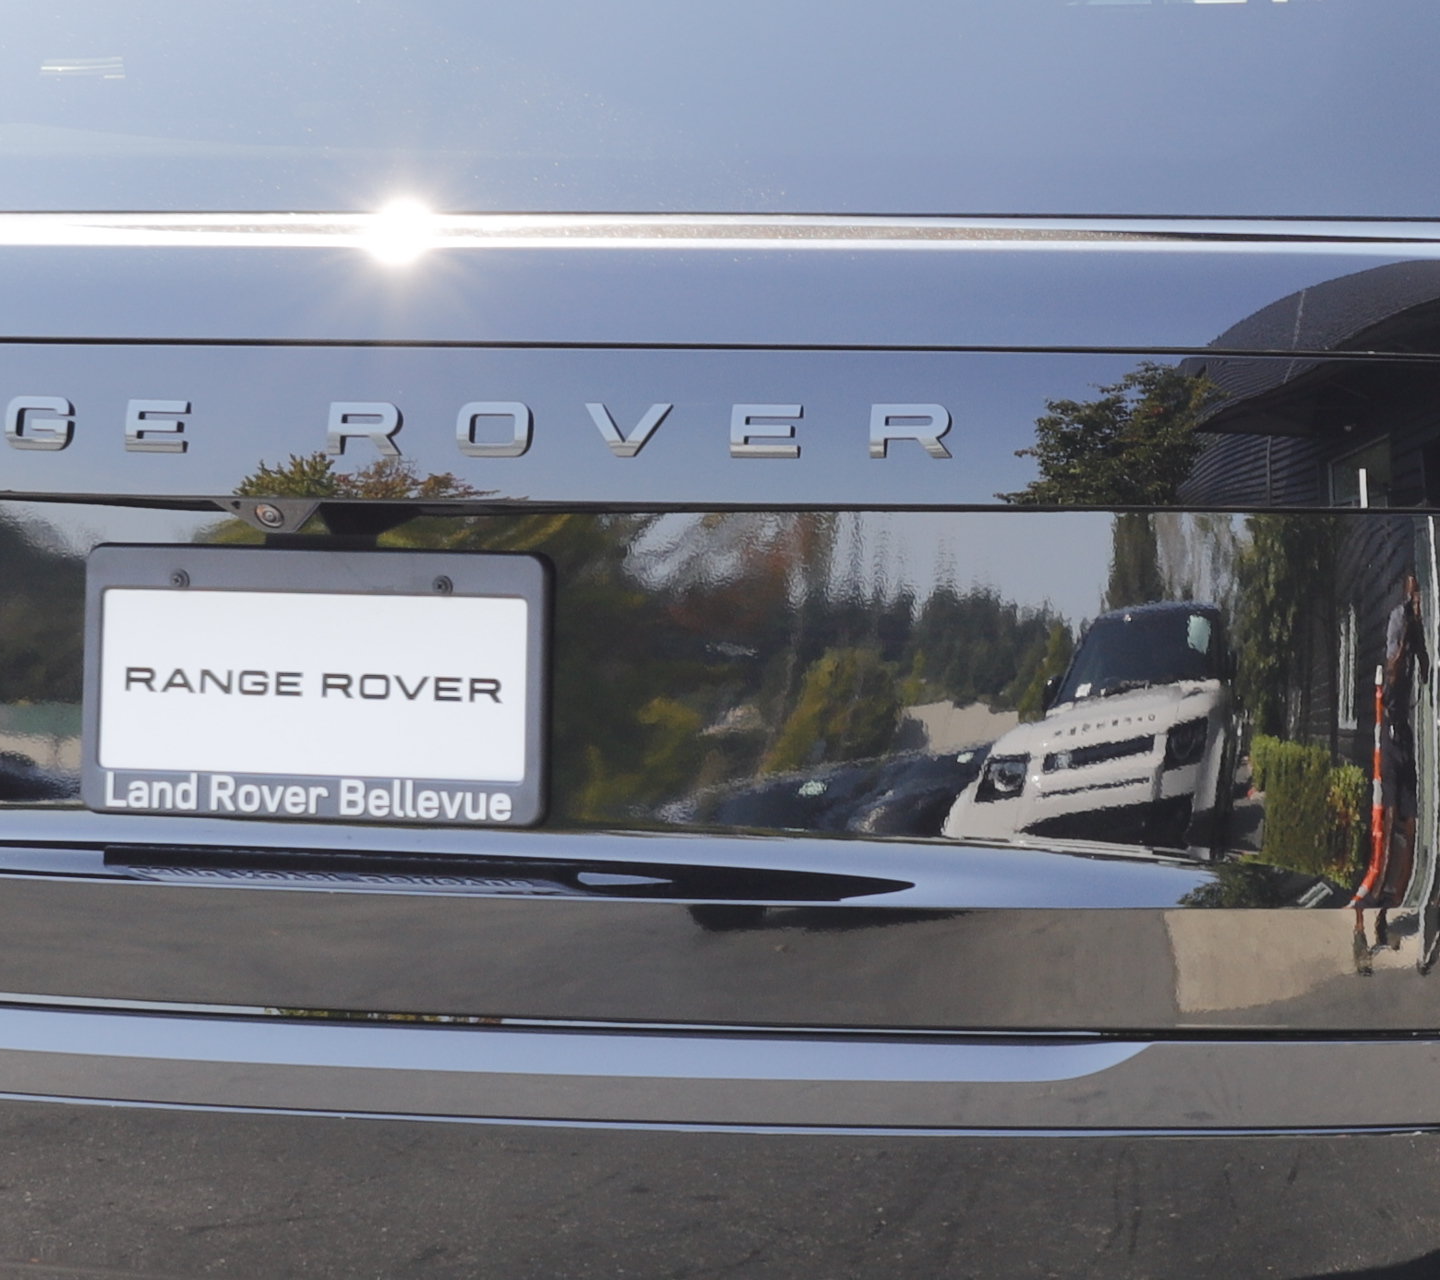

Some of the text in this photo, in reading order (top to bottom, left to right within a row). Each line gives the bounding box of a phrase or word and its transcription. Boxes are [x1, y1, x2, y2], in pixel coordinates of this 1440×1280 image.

[326, 399, 954, 460] ROVER
[125, 666, 502, 704] RANGE ROVER
[105, 771, 512, 821] Land Rover Bellevue
